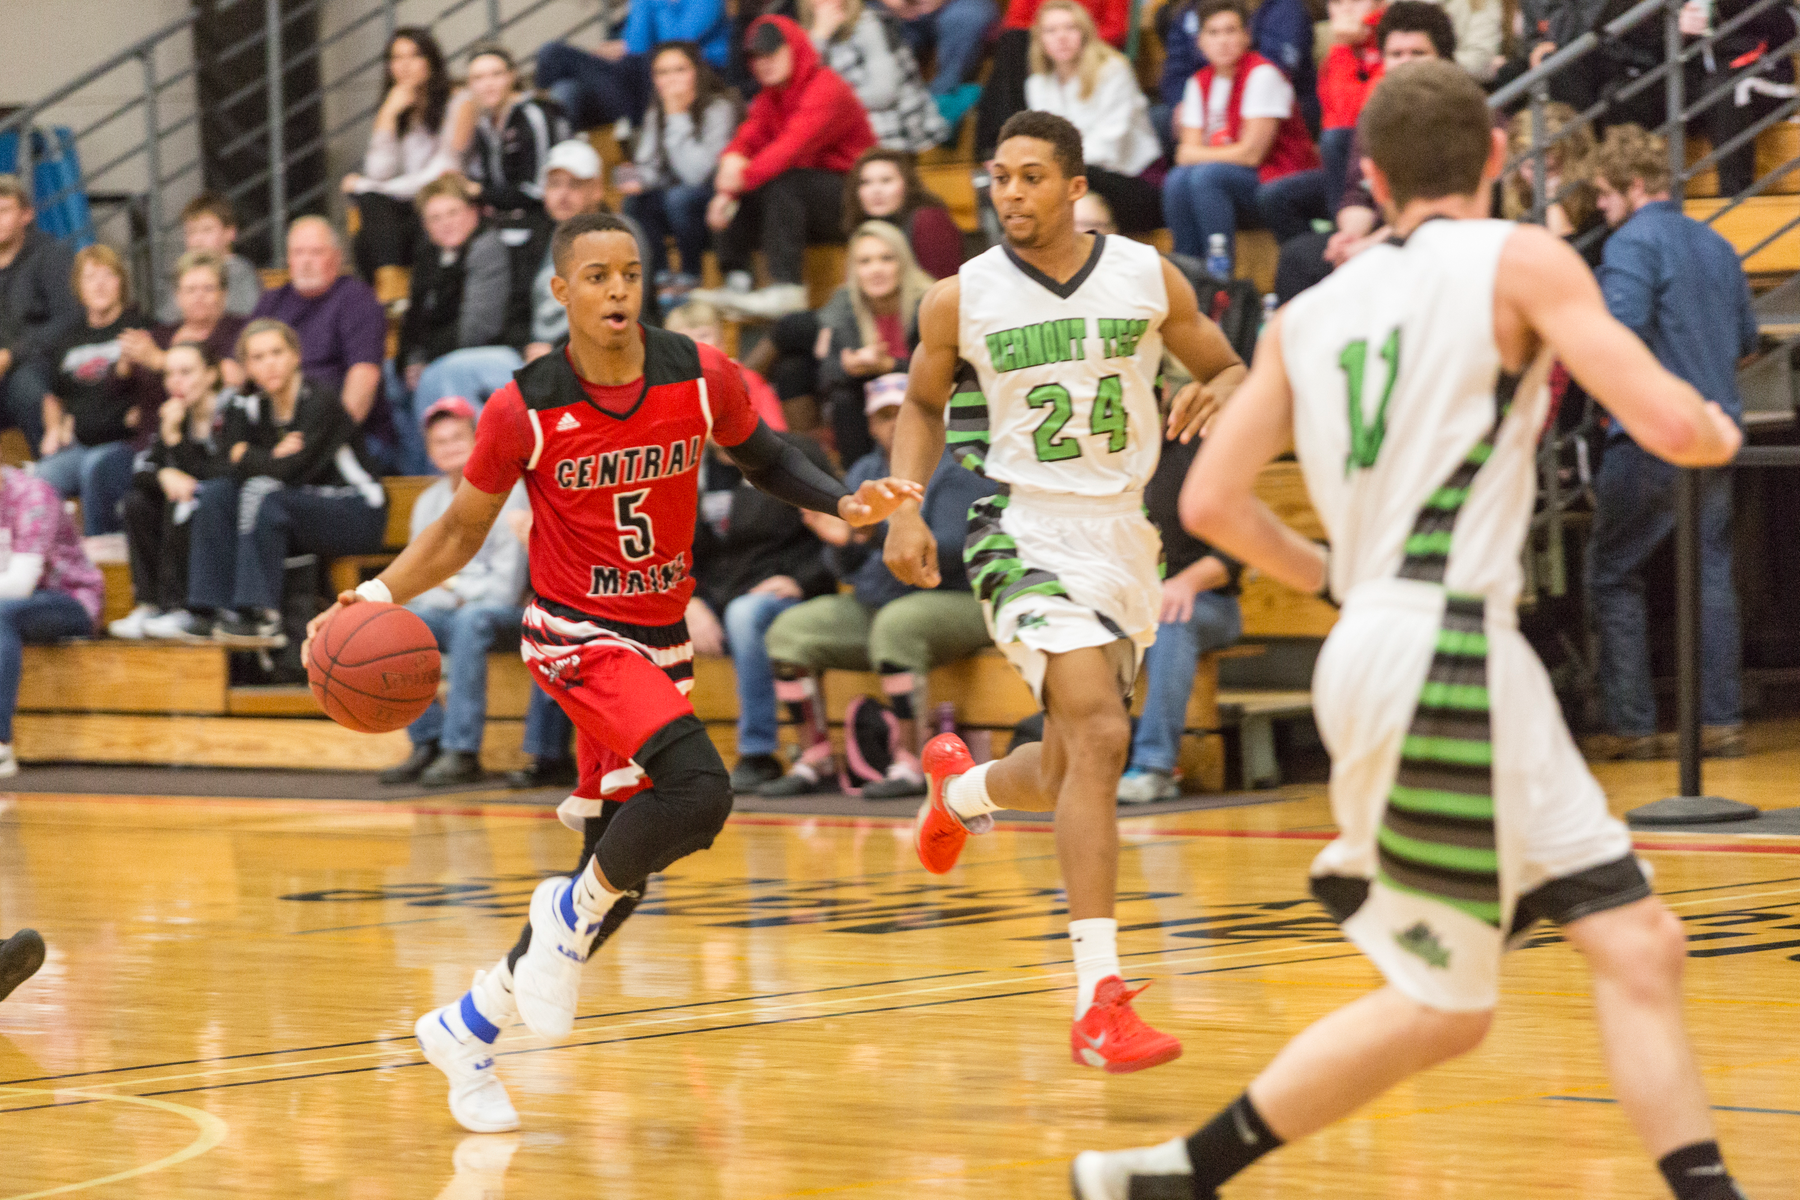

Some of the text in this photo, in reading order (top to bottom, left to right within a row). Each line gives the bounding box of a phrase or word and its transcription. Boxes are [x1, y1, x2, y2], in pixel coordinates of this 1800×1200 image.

[985, 317, 1086, 373] VERMONT
[1026, 373, 1128, 462] 24
[555, 434, 701, 490] CENTRAL
[613, 487, 655, 563] 5
